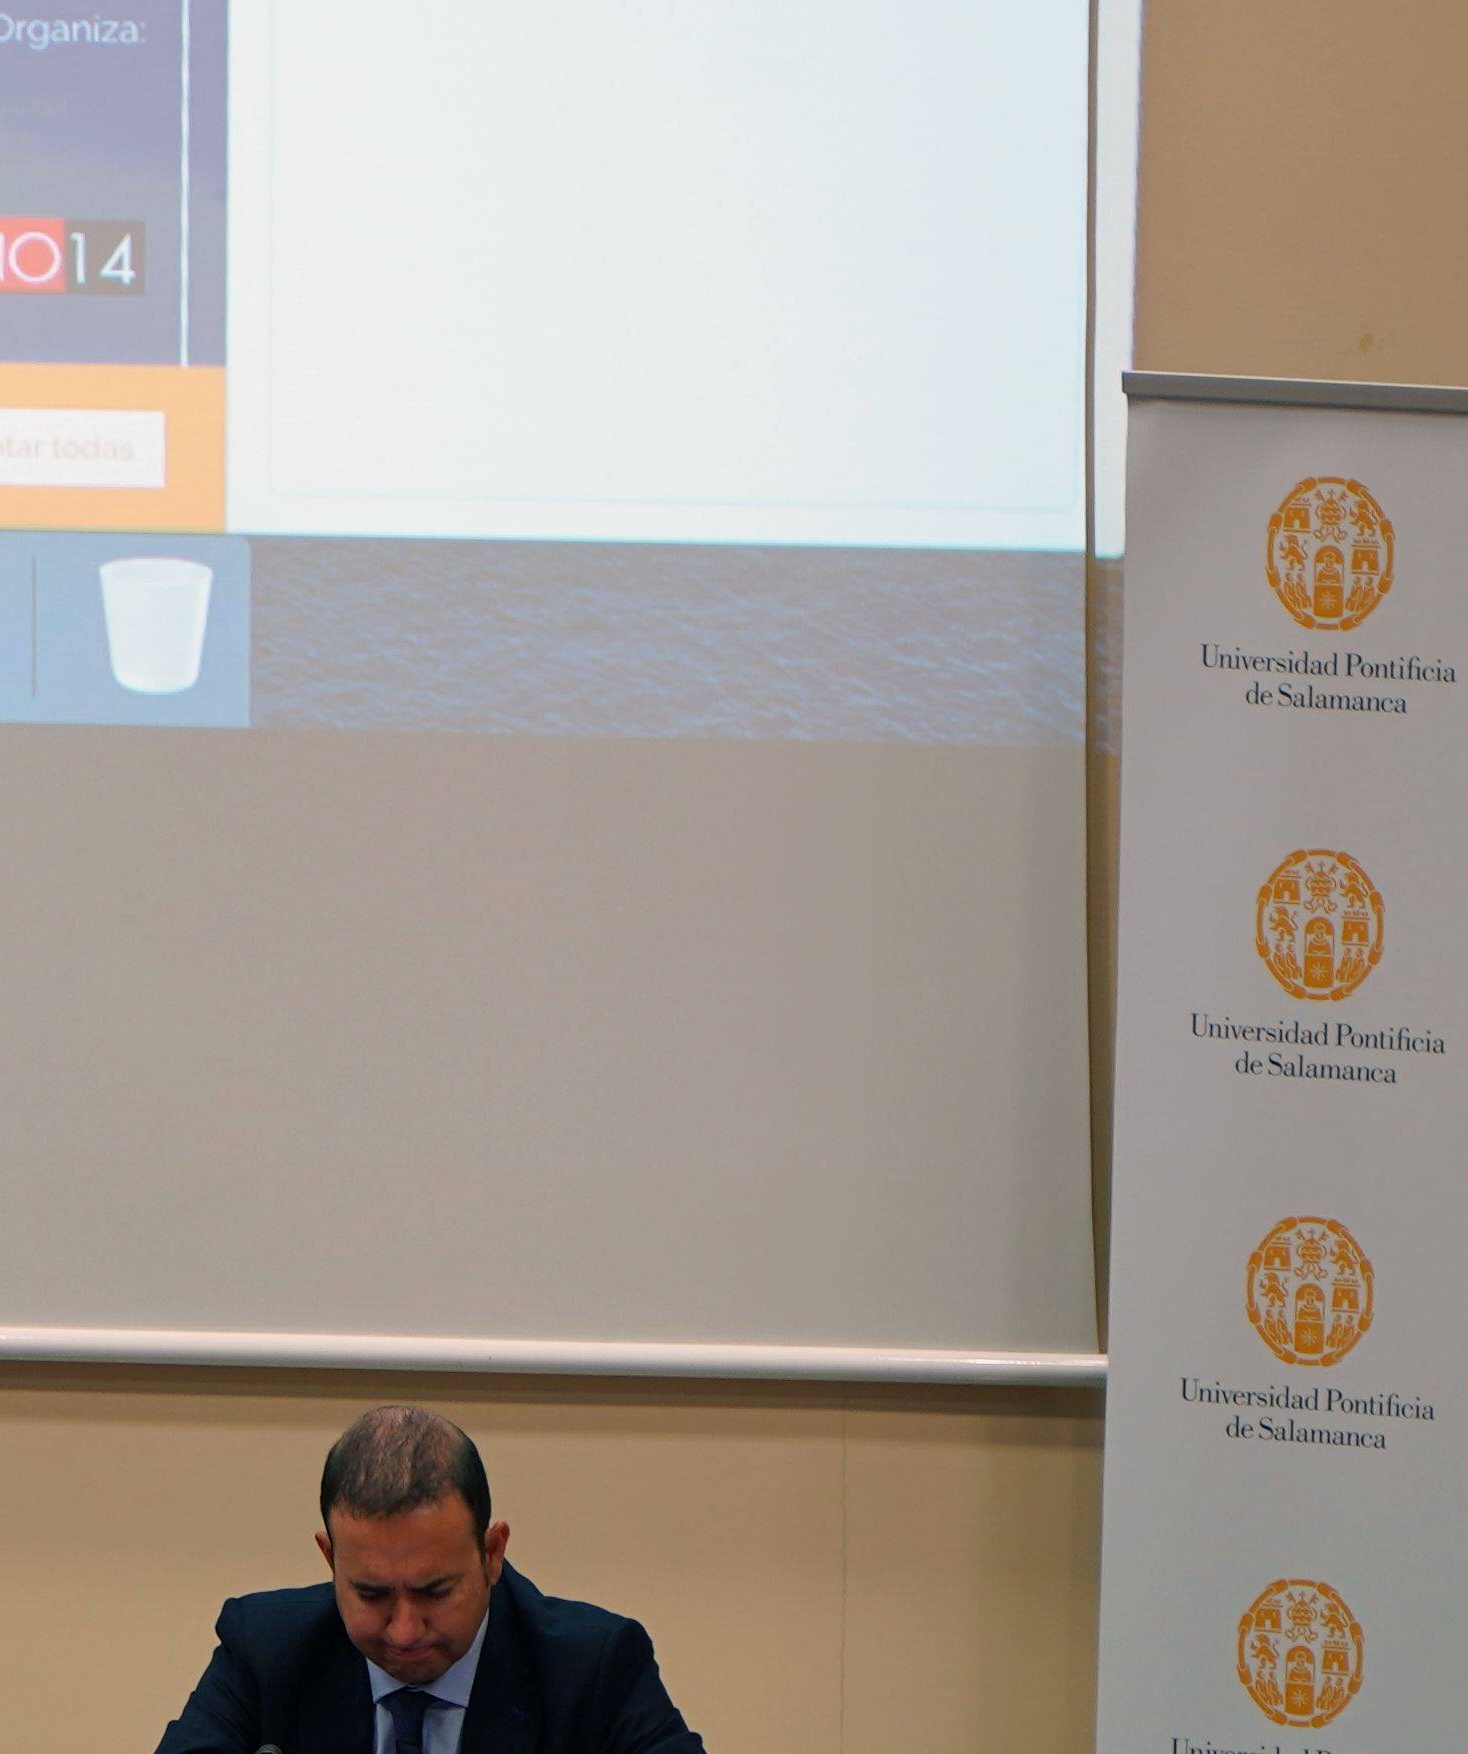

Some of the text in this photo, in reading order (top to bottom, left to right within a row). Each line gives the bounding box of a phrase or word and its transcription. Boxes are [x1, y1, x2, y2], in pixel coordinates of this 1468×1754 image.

[50, 435, 135, 463] todas
[1200, 643, 1458, 685] Universidad Pontificia
[1245, 682, 1408, 716] de Salamanca
[1191, 1013, 1447, 1056] Universidad Pontificia
[1235, 1051, 1399, 1085] de Salamanca
[1179, 1377, 1437, 1422] Universidad Pontificia
[1225, 1417, 1388, 1451] de Salamanca
